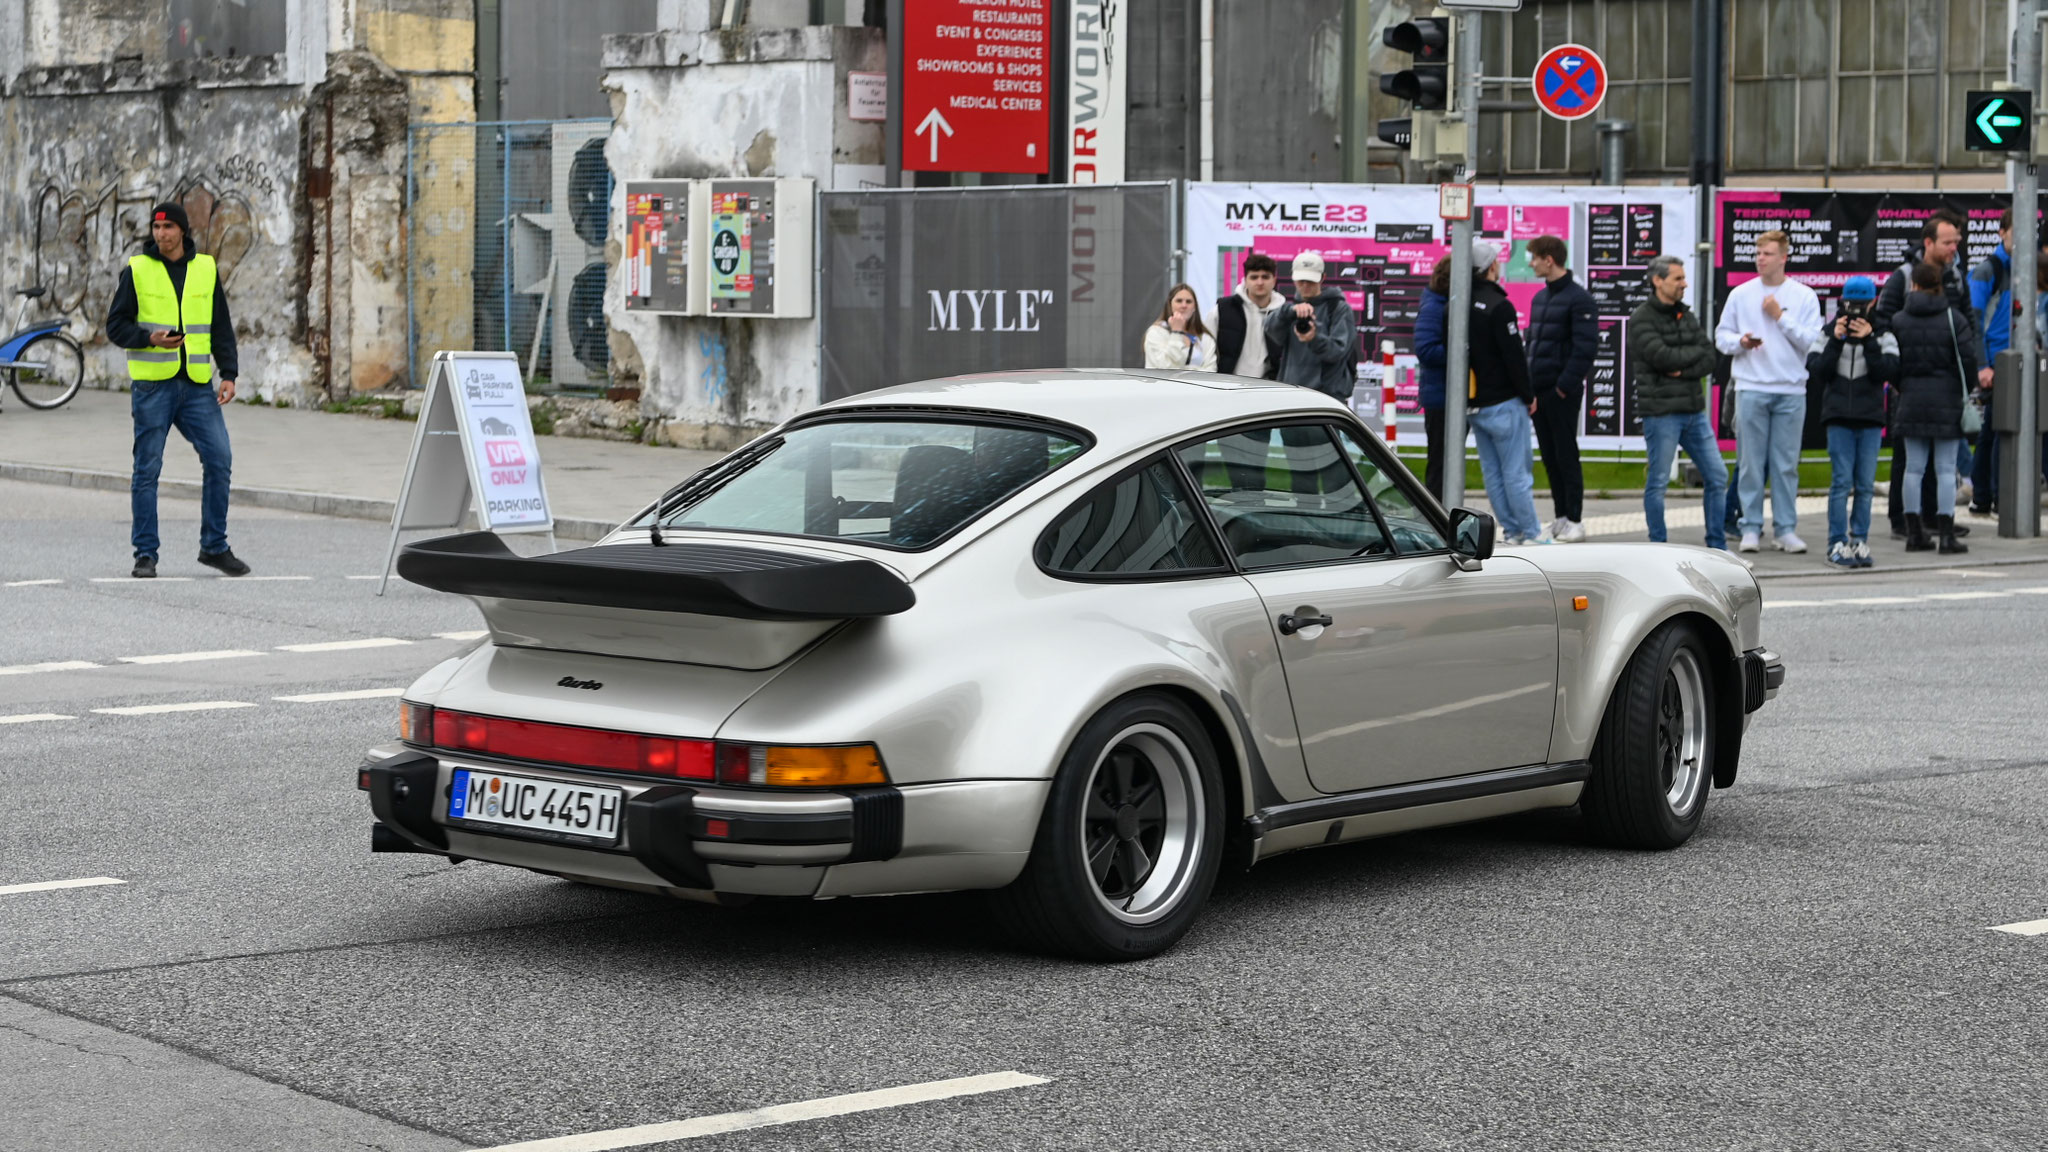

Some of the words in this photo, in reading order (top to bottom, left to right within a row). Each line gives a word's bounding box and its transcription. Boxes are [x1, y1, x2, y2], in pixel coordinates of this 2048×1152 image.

[972, 10, 1043, 26] RESTAURANTS
[936, 25, 971, 38] EVENT
[973, 27, 982, 40] &
[984, 28, 1043, 43] CONGRESS
[976, 44, 1043, 60] EXPERIENCE
[917, 59, 995, 75] SHOWROOMS
[997, 62, 1006, 75] &
[1007, 63, 1043, 77] SHOPS
[993, 79, 1042, 93] SERVICES
[950, 96, 999, 110] MEDICAL
[1001, 97, 1042, 111] CENTER
[1282, 224, 1307, 232] MAI
[1311, 224, 1368, 233] MUNICH
[1733, 220, 1783, 231] GENESIS
[1789, 220, 1832, 232] ALPINE
[1967, 220, 1985, 232] DJ
[1791, 233, 1822, 243] TESLA
[1800, 245, 1832, 255] LEXUS
[927, 289, 1041, 333] MYLE
[487, 443, 522, 465] VIP
[491, 470, 527, 486] ONLY
[488, 497, 543, 514] PARKING
[467, 777, 487, 815] M
[501, 782, 536, 822] UC
